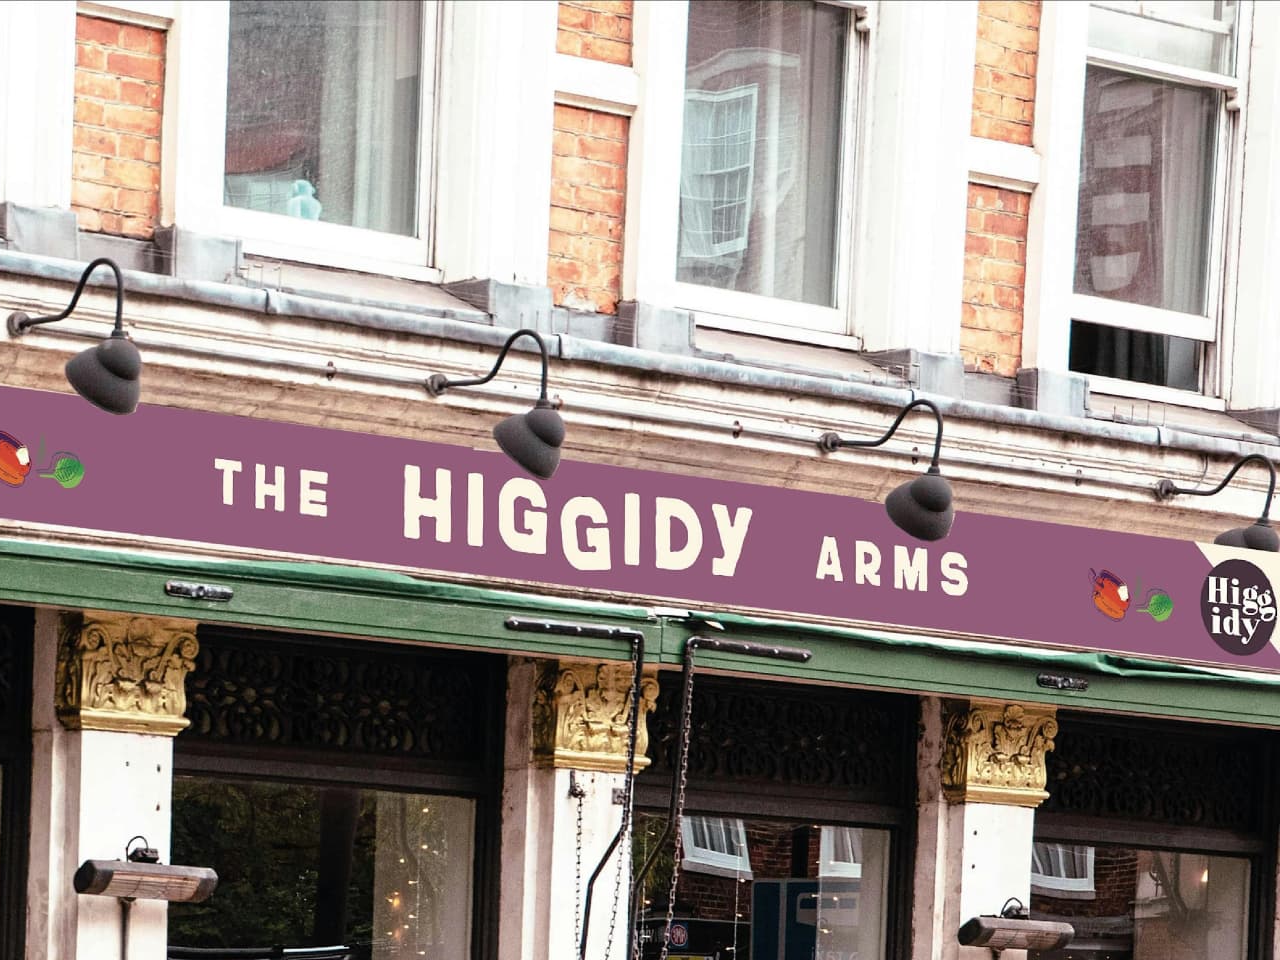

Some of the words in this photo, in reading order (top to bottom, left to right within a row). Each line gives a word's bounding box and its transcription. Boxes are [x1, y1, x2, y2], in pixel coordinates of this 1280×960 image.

[214, 457, 329, 517] THE
[402, 463, 753, 577] HIGGIDY
[815, 534, 969, 597] ARMS
[1207, 576, 1277, 622] Higg
[1211, 606, 1262, 645] idy
